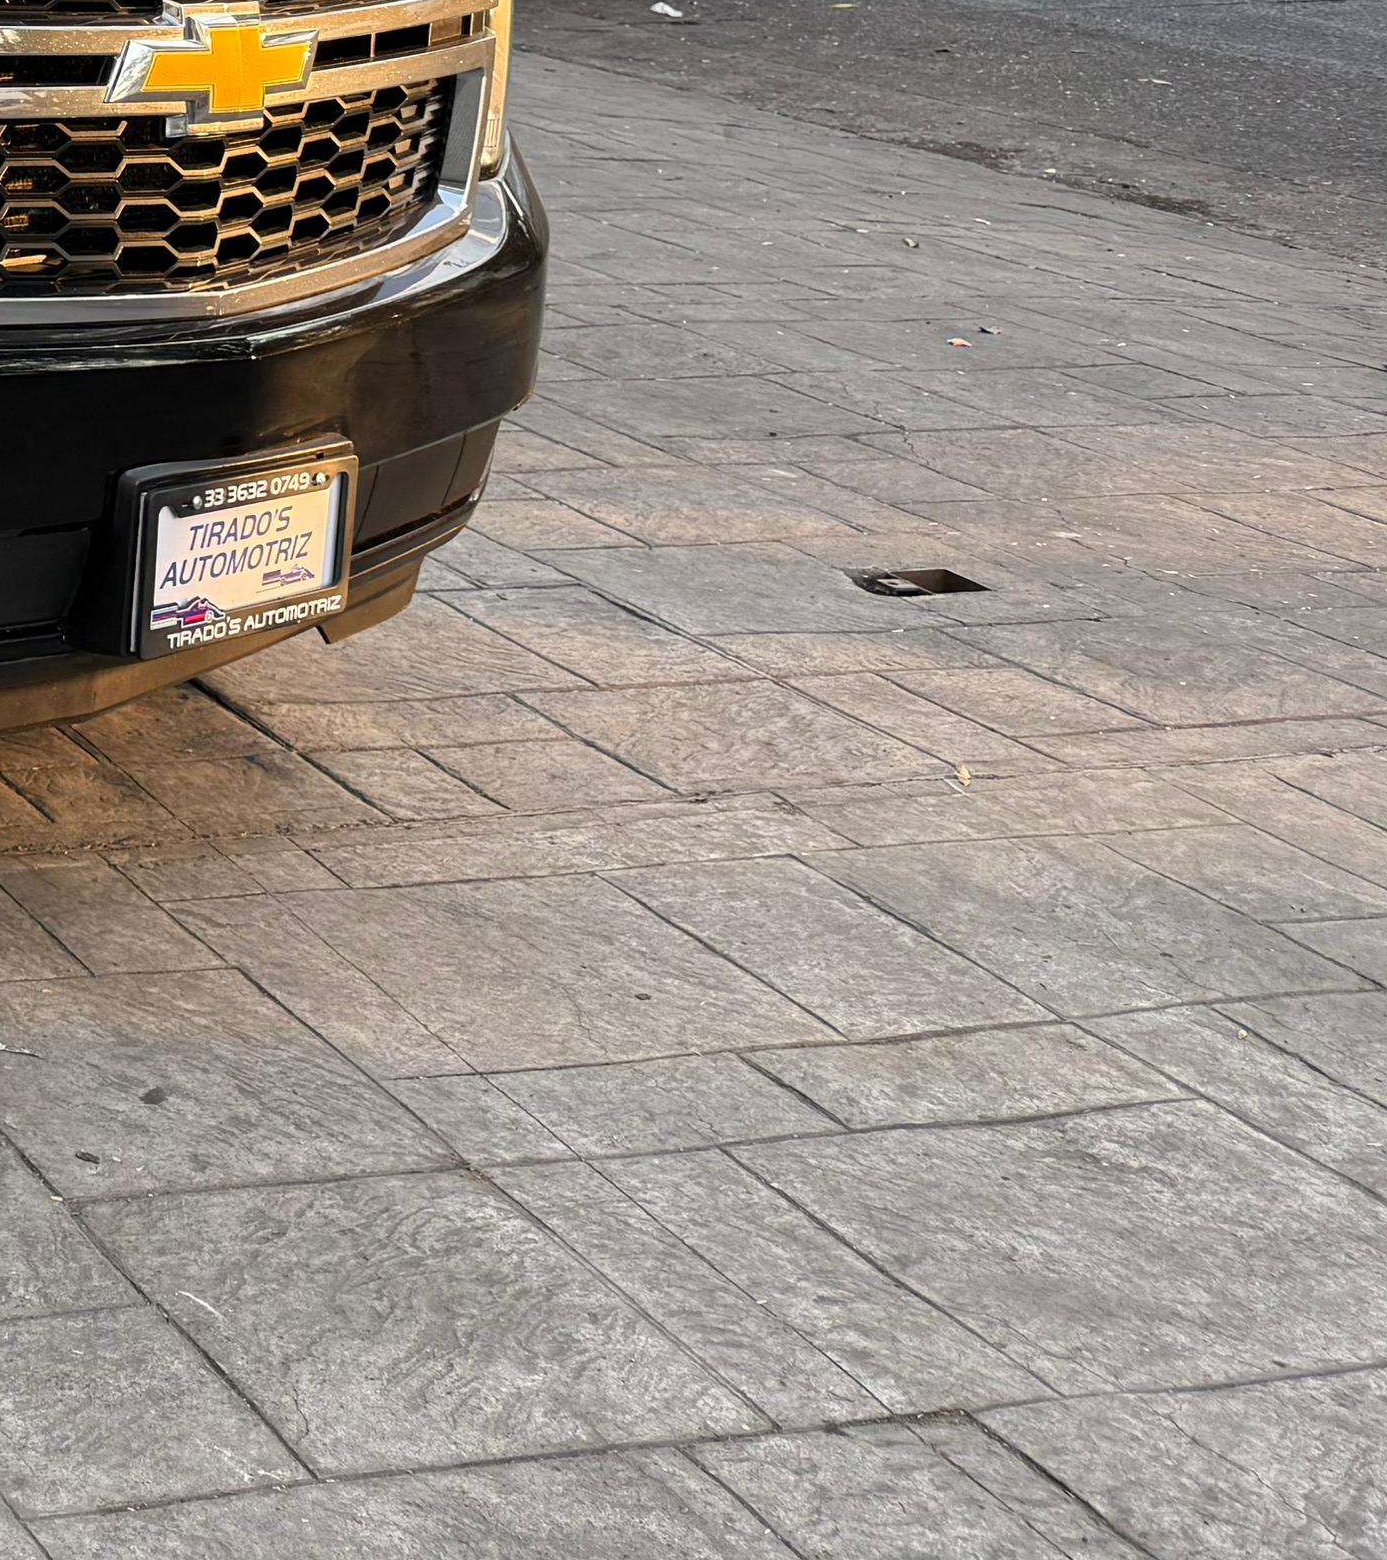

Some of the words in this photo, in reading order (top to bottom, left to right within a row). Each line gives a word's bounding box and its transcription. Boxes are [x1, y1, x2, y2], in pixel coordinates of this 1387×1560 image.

[204, 488, 224, 508] 33
[227, 480, 268, 503] 3632
[271, 471, 311, 495] 0749
[189, 506, 294, 552] TIRADO'S
[159, 531, 313, 590] AUTOMOTRIZ
[167, 617, 242, 649] TIRADO'S
[244, 594, 342, 630] AUTOMOTRIZ
